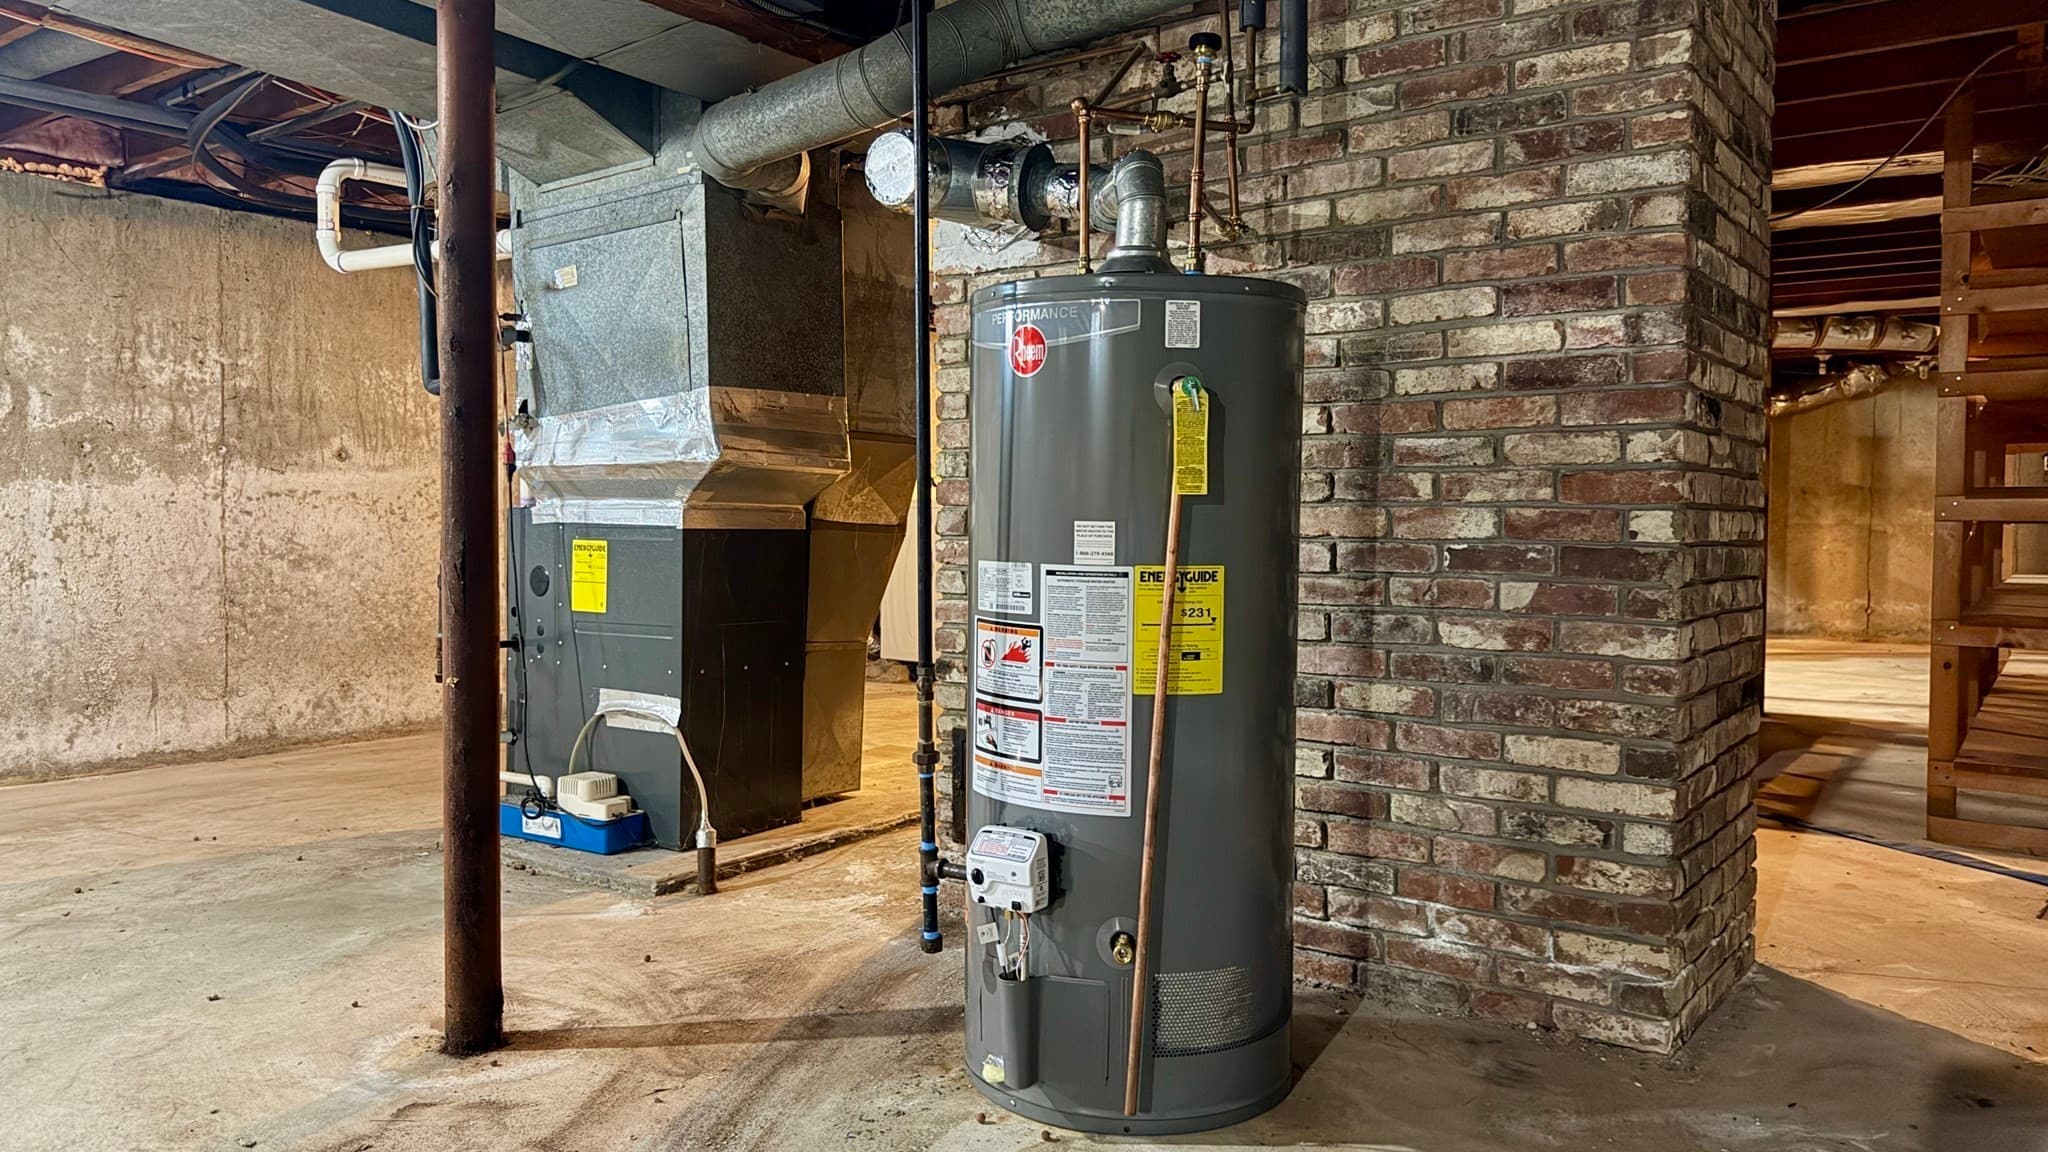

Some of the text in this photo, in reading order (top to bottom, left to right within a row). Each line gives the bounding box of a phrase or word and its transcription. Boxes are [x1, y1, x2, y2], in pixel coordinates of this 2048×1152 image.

[1013, 336, 1044, 368] Rheem
[1140, 571, 1219, 582] ENEYGUIDE
[1181, 608, 1211, 617] $231
